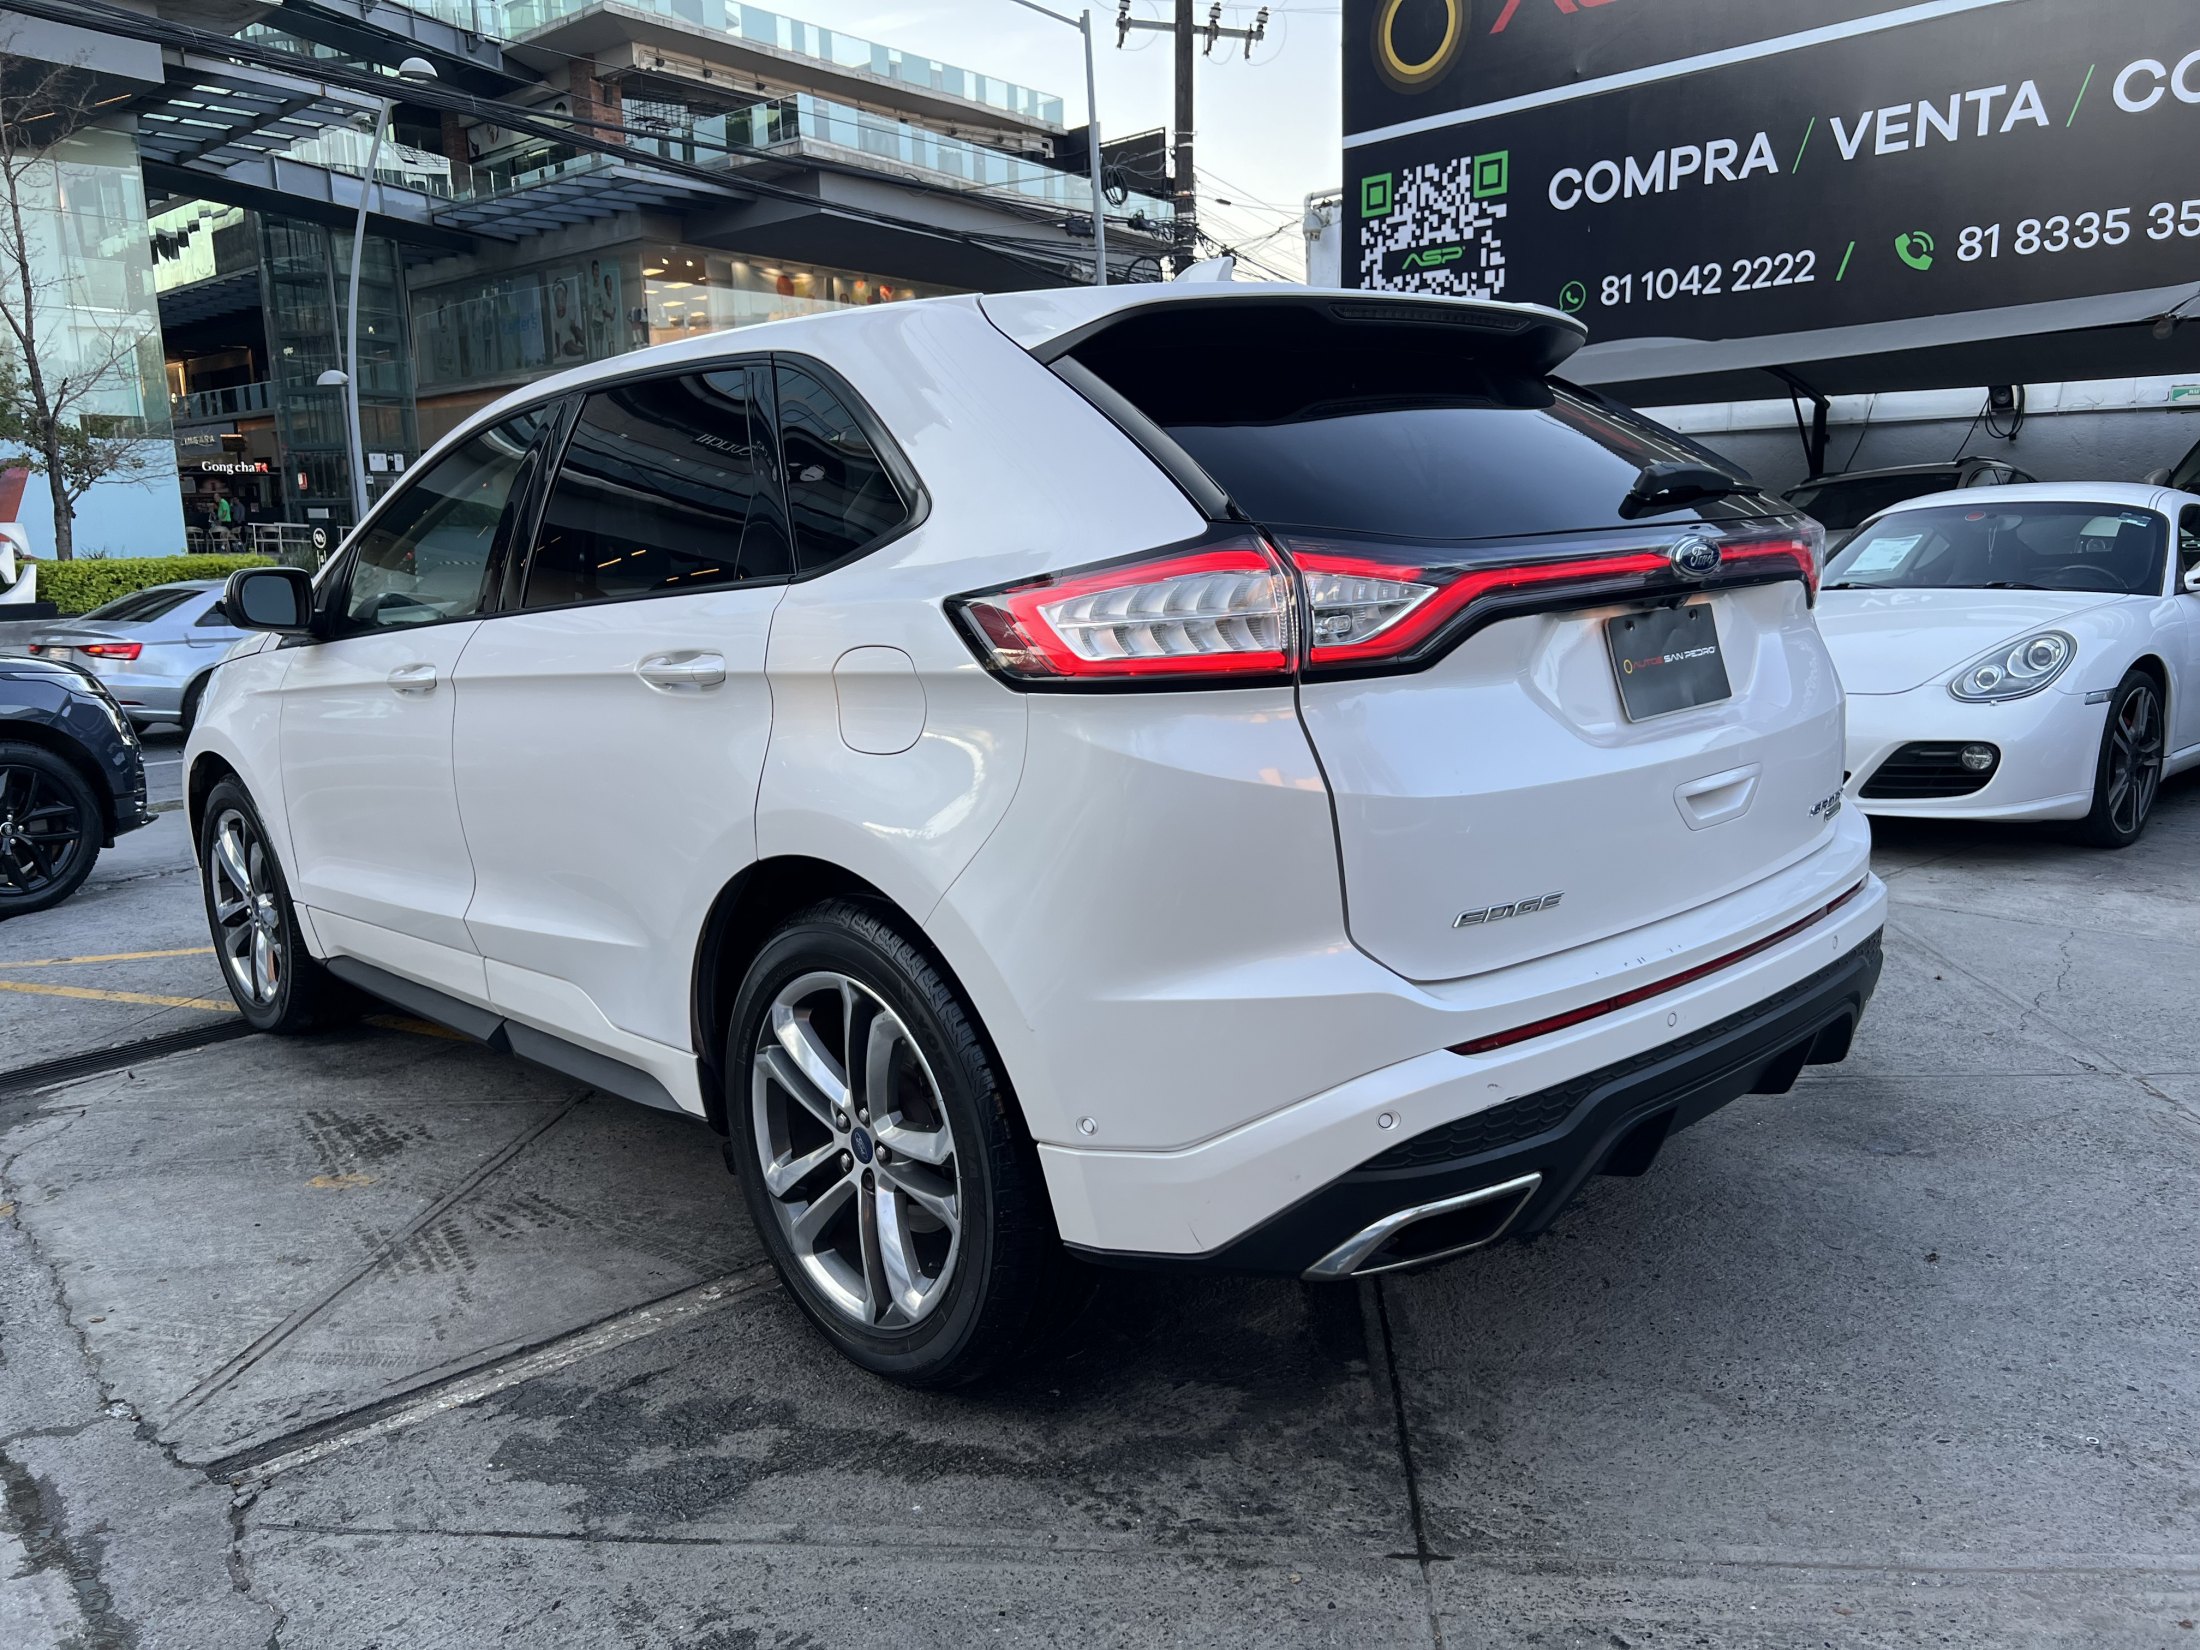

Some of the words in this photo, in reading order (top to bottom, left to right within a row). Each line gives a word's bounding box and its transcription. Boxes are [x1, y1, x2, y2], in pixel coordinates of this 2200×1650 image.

[1548, 131, 1779, 211] COMPRA
[1829, 79, 2050, 161] VENTA
[1402, 246, 1463, 269] ASP
[1600, 273, 1632, 306] 81
[1641, 262, 1723, 301] 1042
[1731, 249, 1816, 292] 2222
[1956, 223, 2000, 262] 81
[2014, 207, 2131, 255] 8335
[201, 461, 234, 475] Gong
[234, 461, 255, 473] cha
[1689, 545, 1716, 567] Ford
[1663, 653, 1685, 663] SAN
[1685, 646, 1716, 659] PEDRO
[1452, 889, 1565, 929] EDGE
